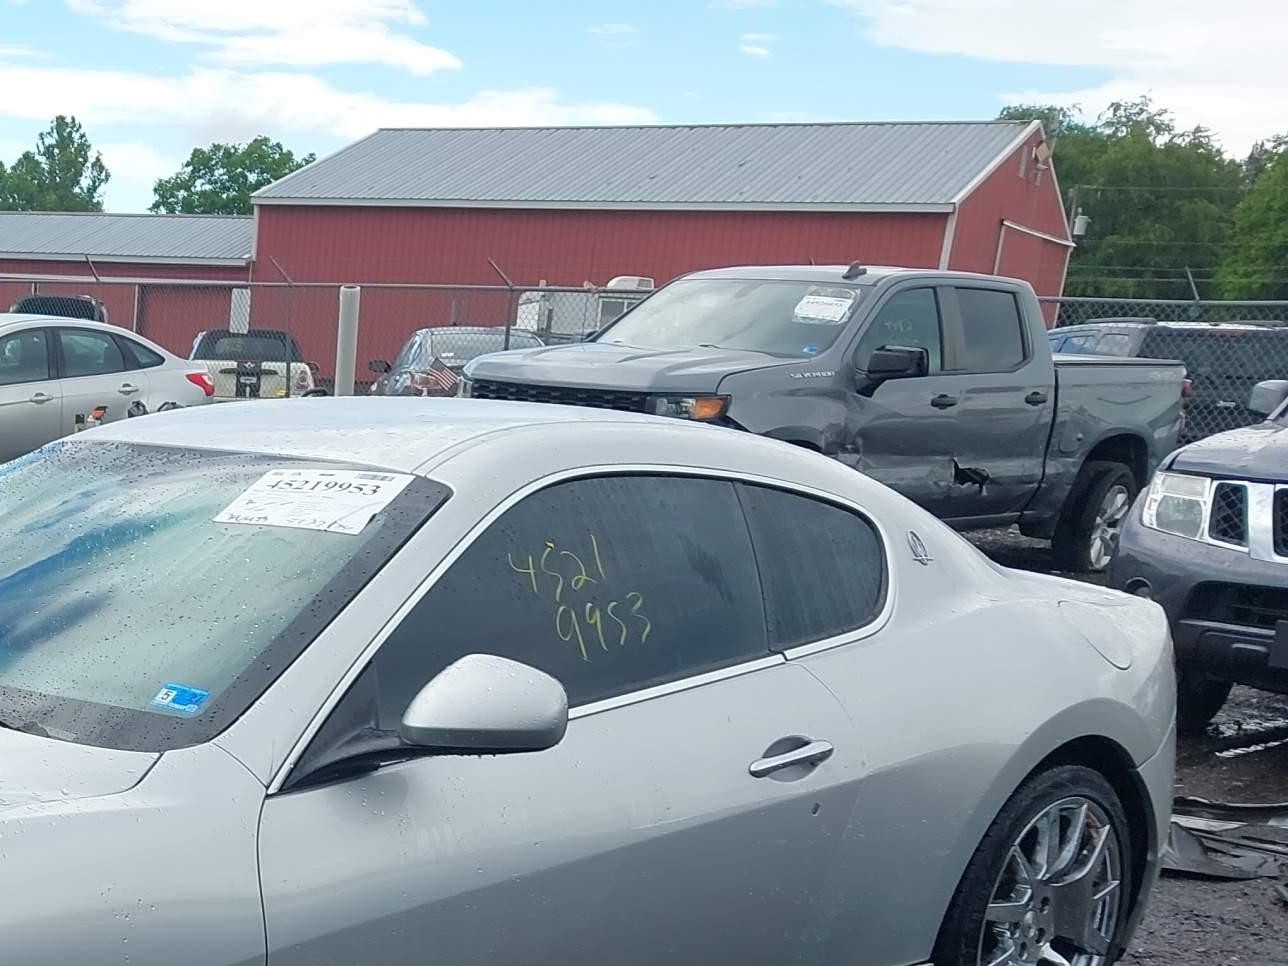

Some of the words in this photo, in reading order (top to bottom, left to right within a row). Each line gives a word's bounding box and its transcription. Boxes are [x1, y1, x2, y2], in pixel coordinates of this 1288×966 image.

[266, 479, 382, 496] 45219953
[508, 534, 606, 602] 4521
[556, 592, 651, 663] 9953
